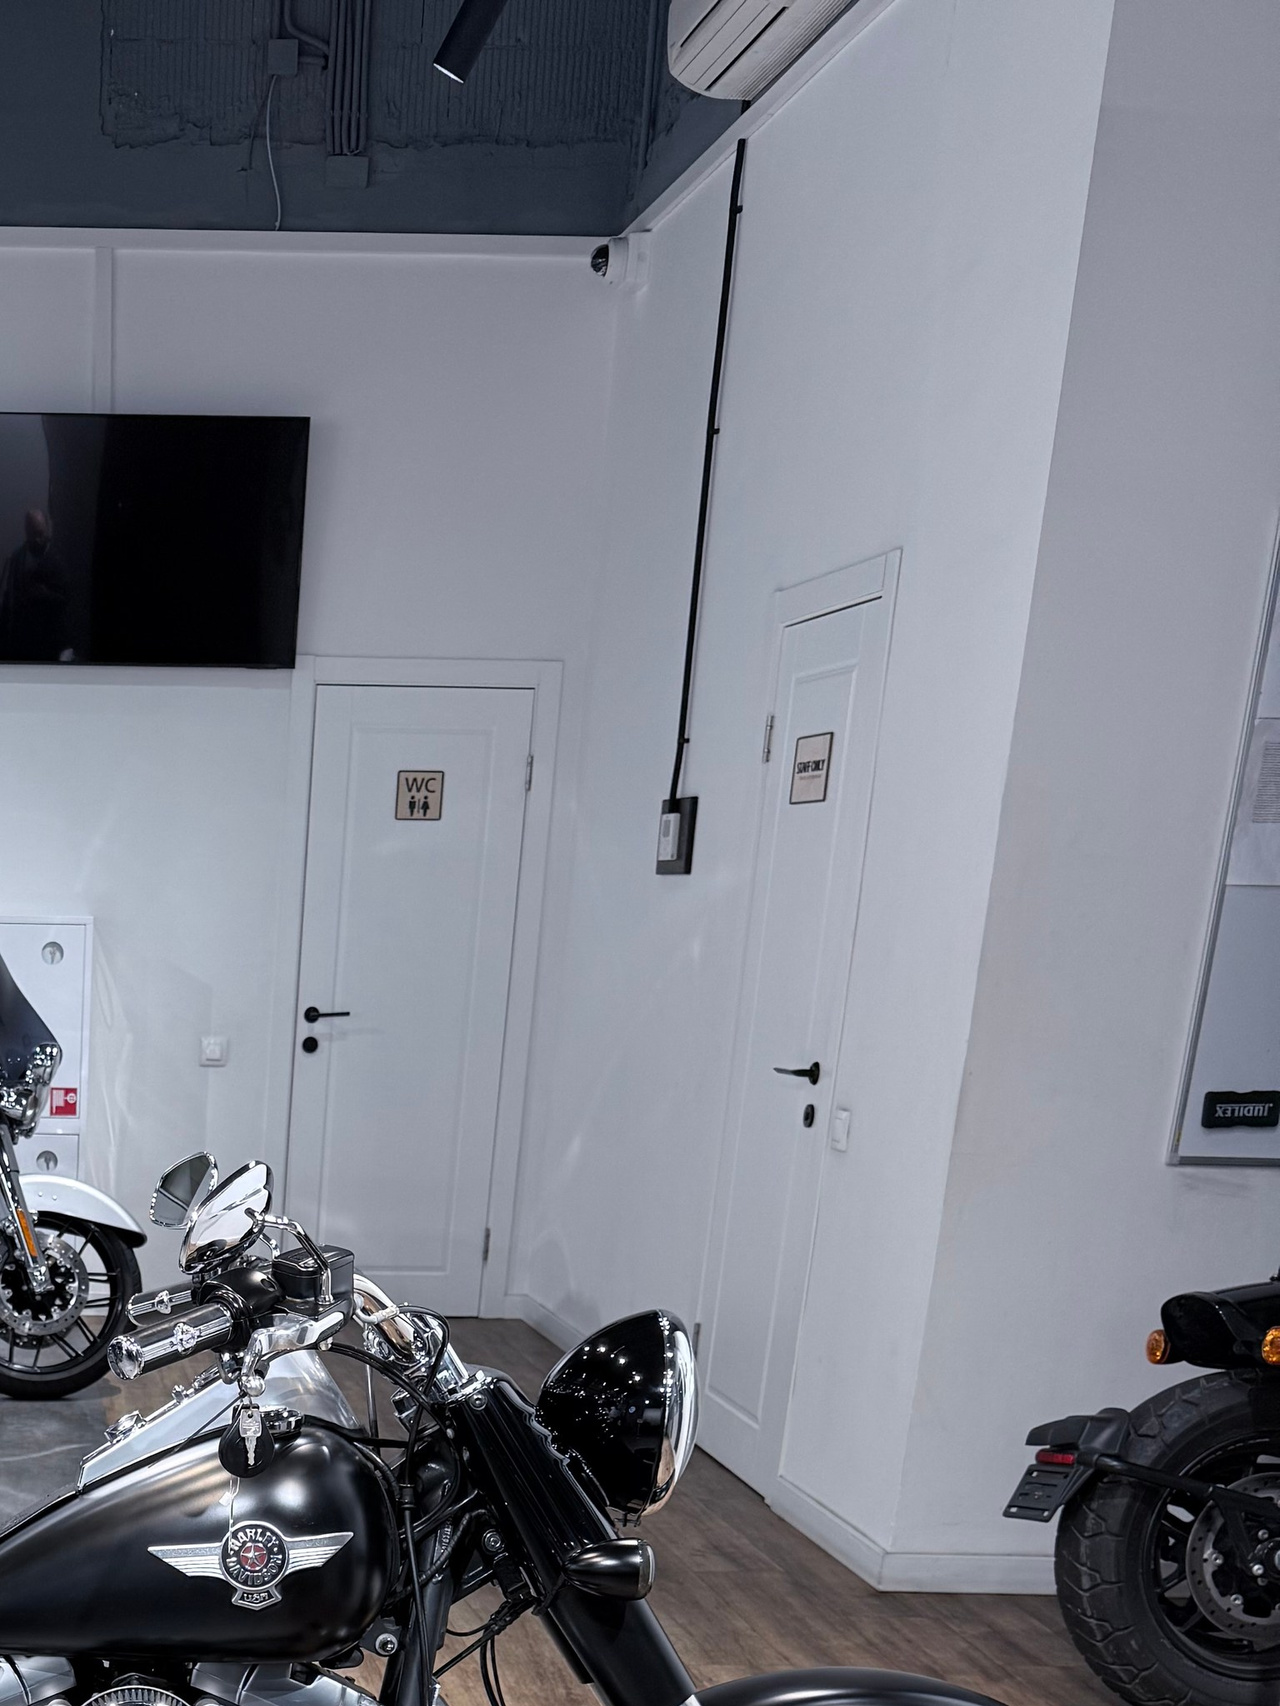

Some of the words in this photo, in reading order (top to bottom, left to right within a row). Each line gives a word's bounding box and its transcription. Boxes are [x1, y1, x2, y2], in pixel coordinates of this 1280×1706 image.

[405, 777, 437, 793] WC
[230, 1527, 279, 1550] HARLEY
[226, 1554, 284, 1586] DAVIDSON
[243, 1592, 269, 1603] USA
